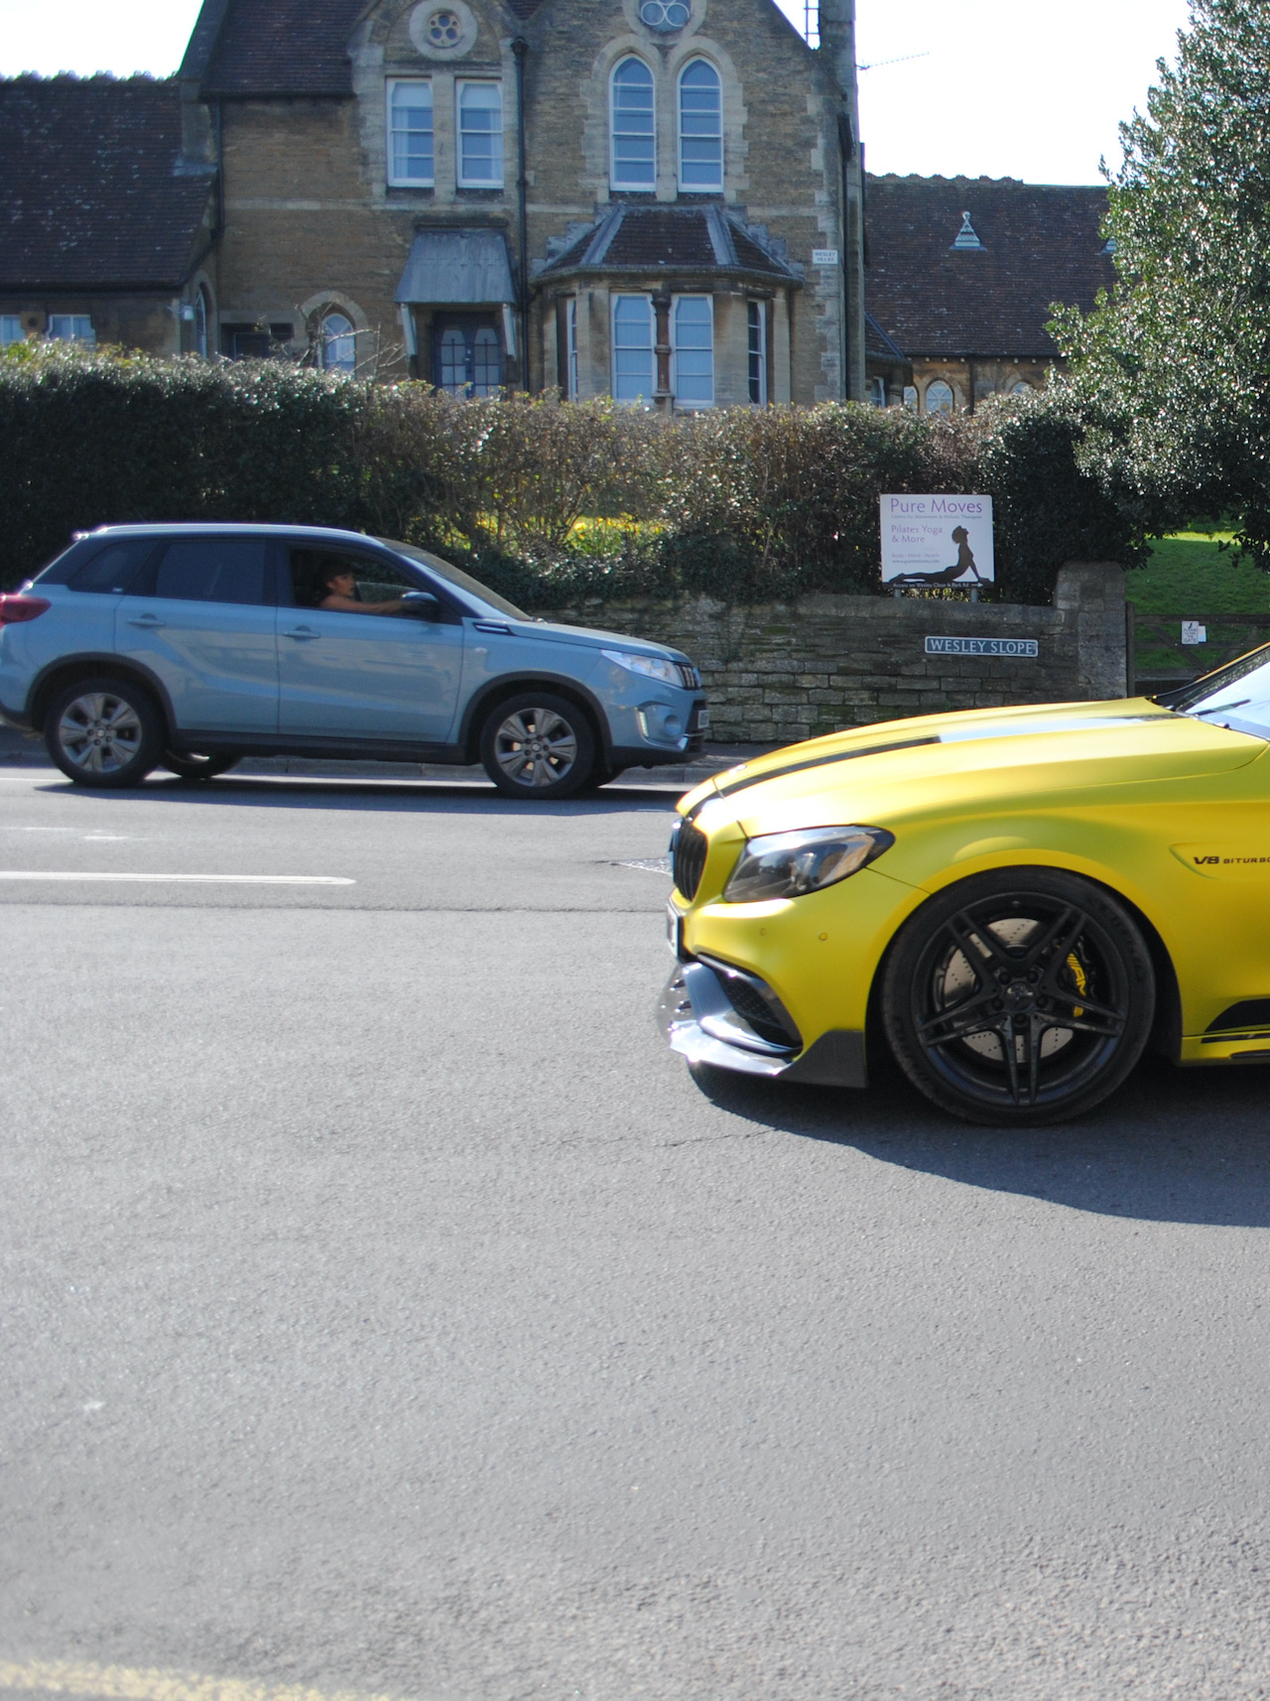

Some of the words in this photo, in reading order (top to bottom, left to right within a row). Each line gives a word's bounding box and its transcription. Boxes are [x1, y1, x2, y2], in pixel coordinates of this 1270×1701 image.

[890, 498, 926, 513] Pure
[931, 499, 983, 513] Moves
[891, 525, 919, 534] Pilates
[922, 525, 943, 536] Yoga
[891, 535, 899, 543] &
[901, 534, 926, 543] More
[930, 639, 986, 652] WESLEY
[990, 641, 1034, 654] SLOPE
[1194, 856, 1220, 865] V8
